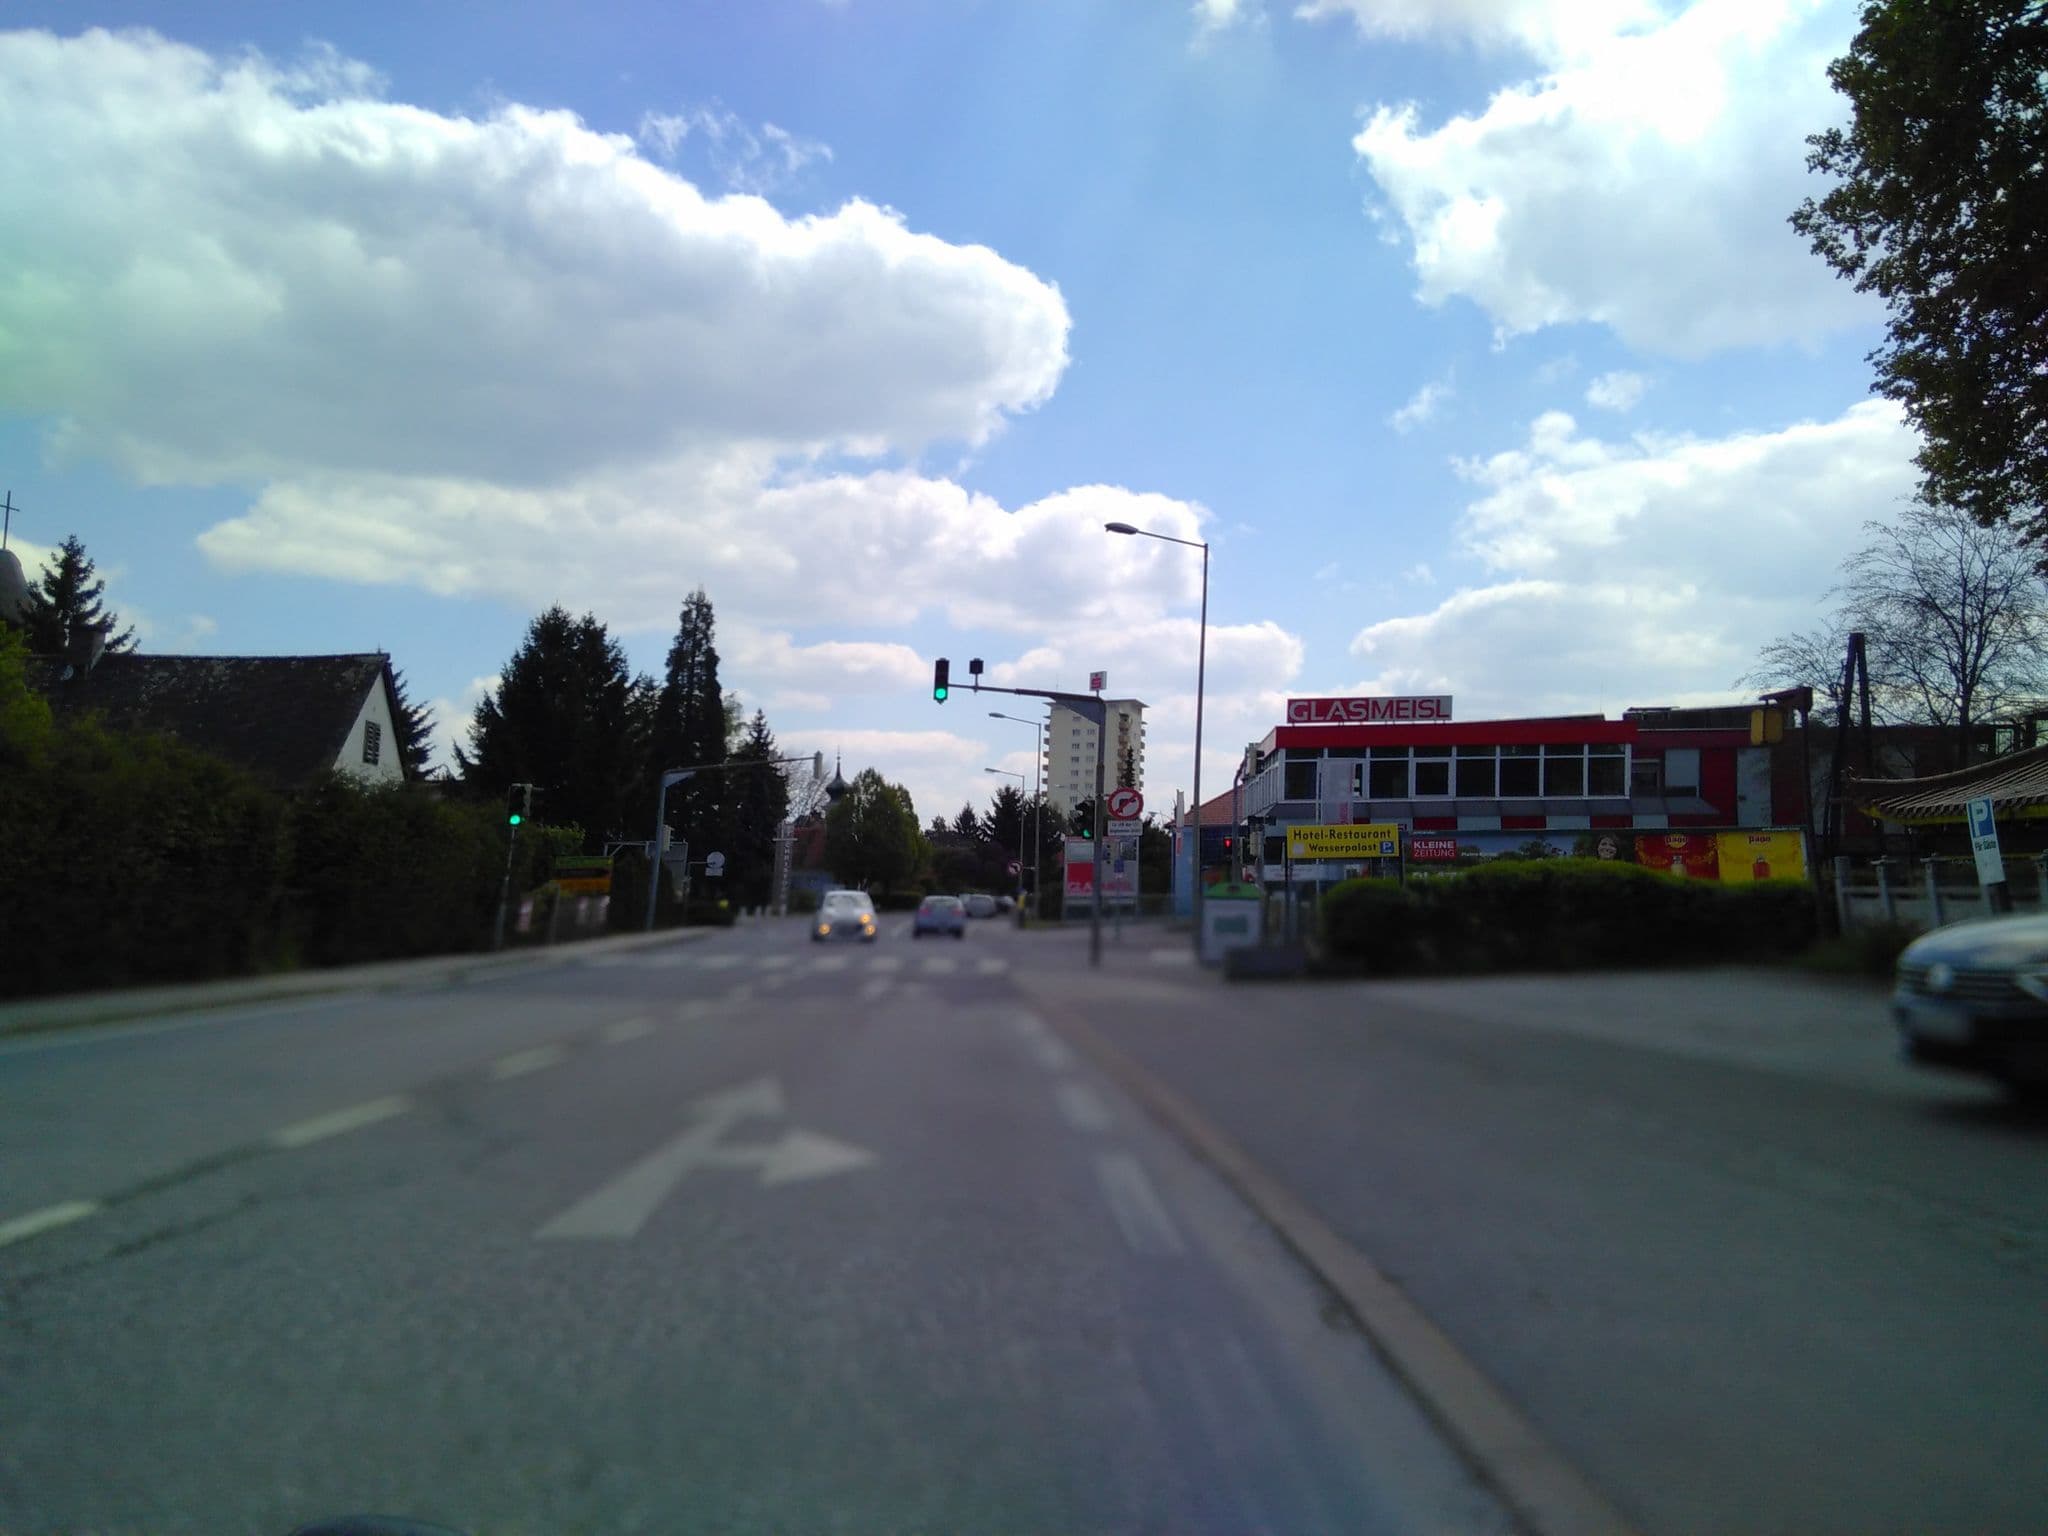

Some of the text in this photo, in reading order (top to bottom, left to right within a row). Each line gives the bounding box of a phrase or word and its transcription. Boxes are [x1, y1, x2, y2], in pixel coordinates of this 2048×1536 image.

[1293, 828, 1391, 841] Hotel-Restaurant
[1308, 843, 1377, 854] Wasserpalast
[1413, 840, 1455, 849] KLEINE
[1413, 849, 1455, 857] ZEITUNG
